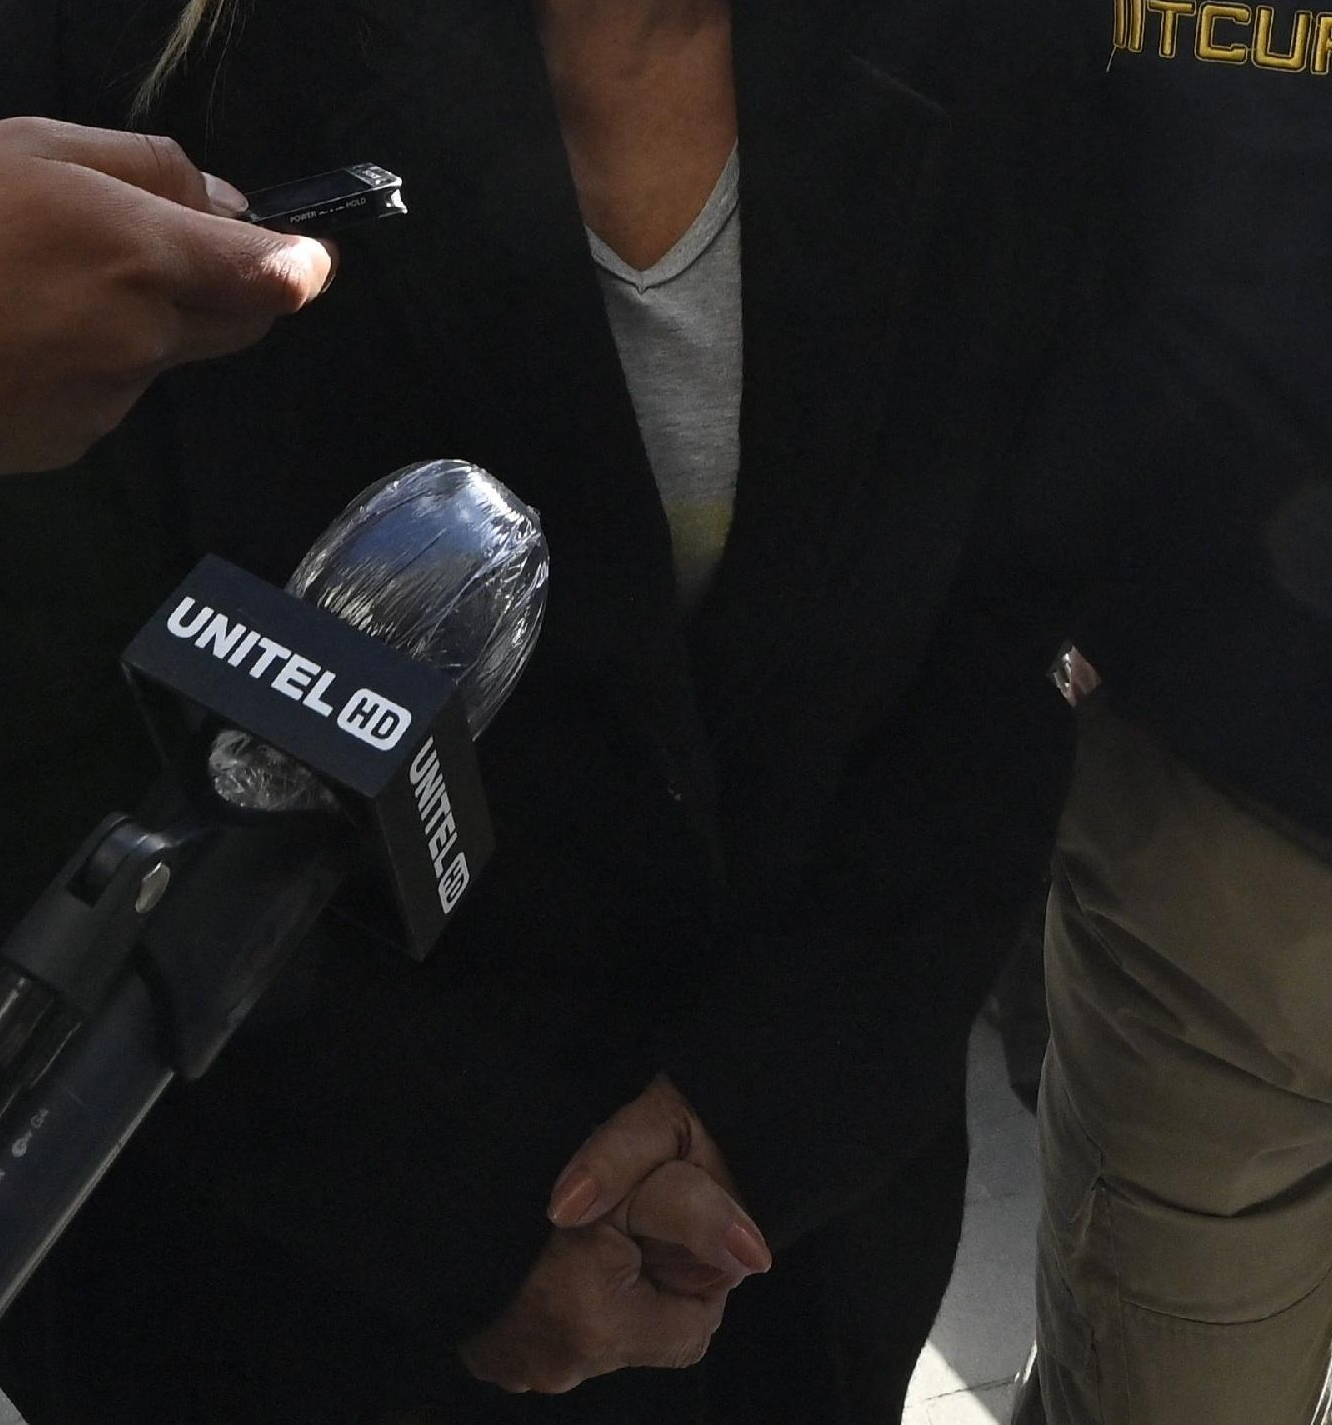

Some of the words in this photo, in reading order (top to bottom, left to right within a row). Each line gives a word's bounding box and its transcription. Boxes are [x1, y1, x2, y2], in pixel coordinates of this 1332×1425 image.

[289, 210, 317, 223] POWER
[346, 197, 368, 208] HOLD
[167, 596, 336, 718] UNITEL
[345, 695, 403, 742] HD
[410, 735, 458, 878] UNITEL
